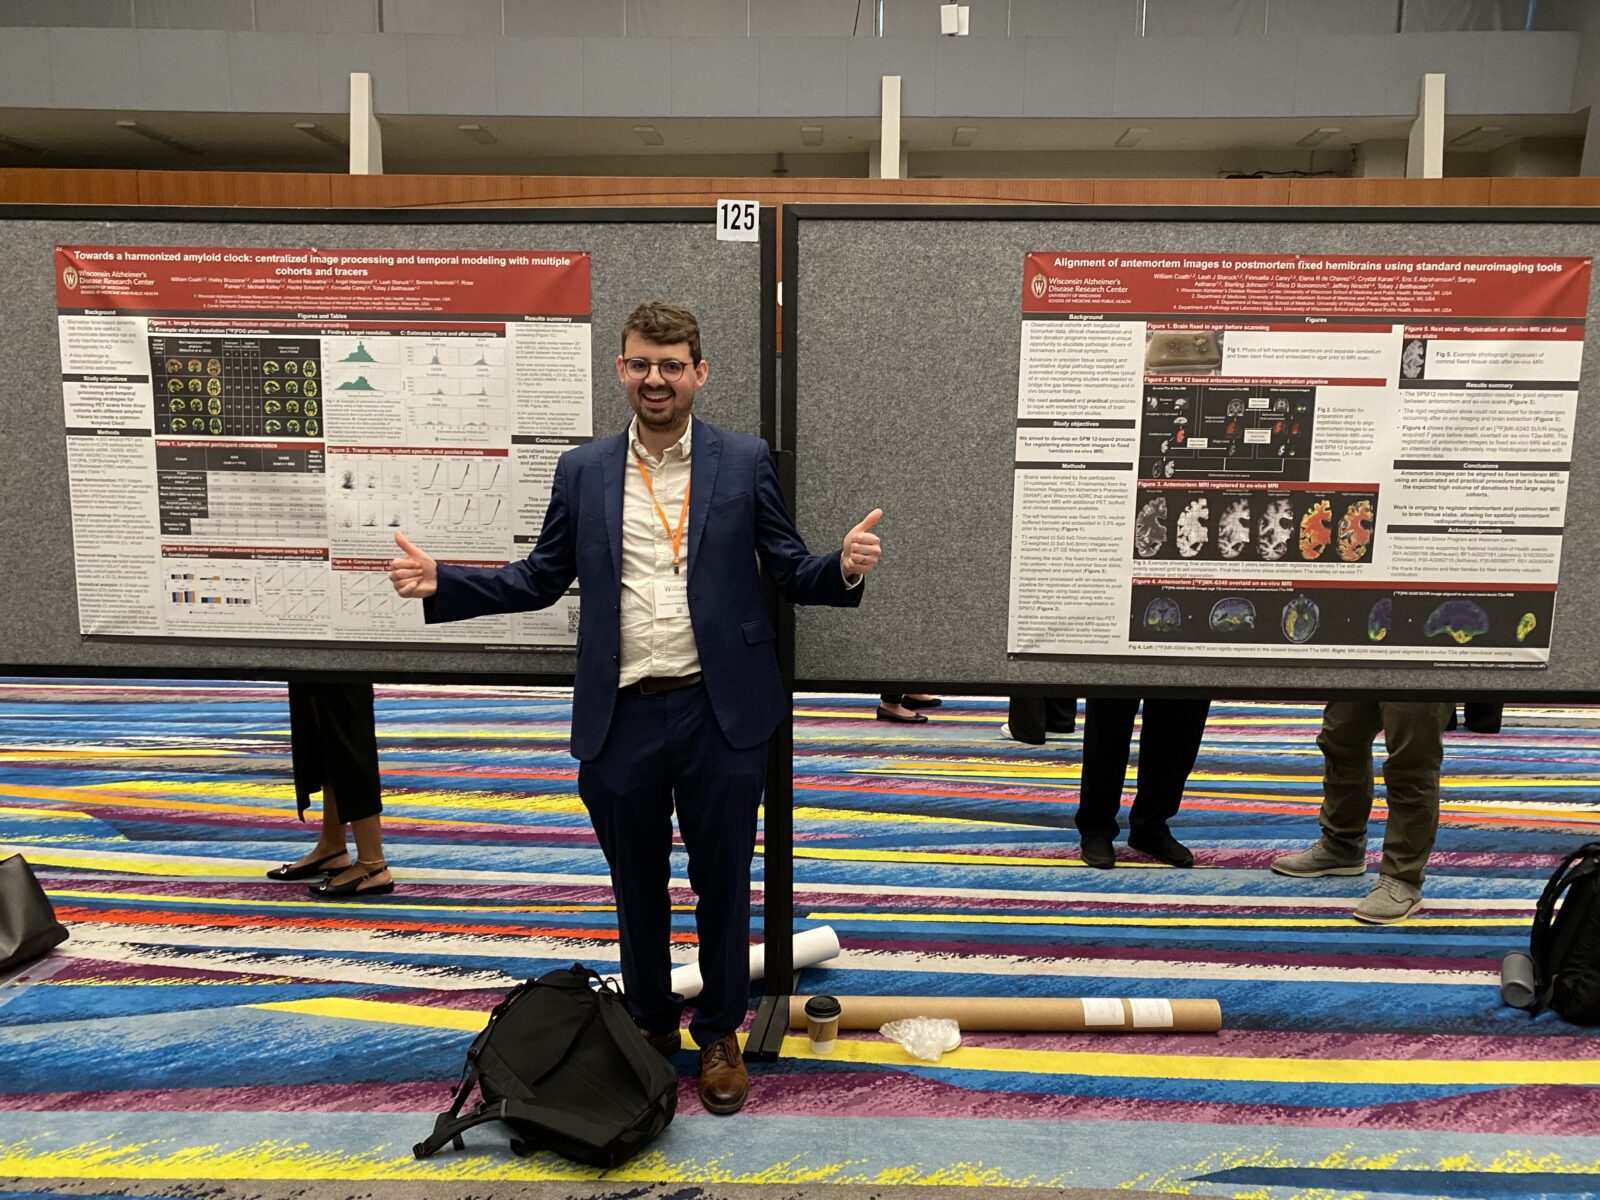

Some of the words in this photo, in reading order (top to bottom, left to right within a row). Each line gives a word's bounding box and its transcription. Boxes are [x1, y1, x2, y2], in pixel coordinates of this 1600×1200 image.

[721, 204, 754, 230] 125
[74, 250, 114, 260] Towards
[124, 251, 181, 261] harmonized
[182, 252, 221, 264] amyloid
[223, 252, 252, 262] clock:
[254, 253, 307, 263] centralized
[309, 253, 338, 265] image
[340, 254, 394, 266] processing
[396, 254, 414, 264] and
[416, 254, 459, 267] temporal
[461, 255, 506, 267] modeling
[508, 256, 529, 265] with
[530, 256, 570, 268] multiple
[1054, 257, 1105, 270] Alignment
[1107, 258, 1118, 267] of
[1120, 259, 1181, 268] antemortem
[1183, 258, 1219, 271] images
[1221, 260, 1232, 268] to
[1234, 260, 1296, 271] postmortem
[1297, 260, 1323, 269] fixed
[1325, 260, 1382, 270] hemibrains
[1384, 260, 1413, 272] using
[1415, 261, 1461, 271] standard
[1463, 261, 1533, 274] neuroimaging
[1535, 262, 1562, 272] tools
[275, 266, 312, 276] cohorts
[314, 267, 332, 276] and
[334, 268, 368, 276] tracers
[1035, 282, 1043, 291] W
